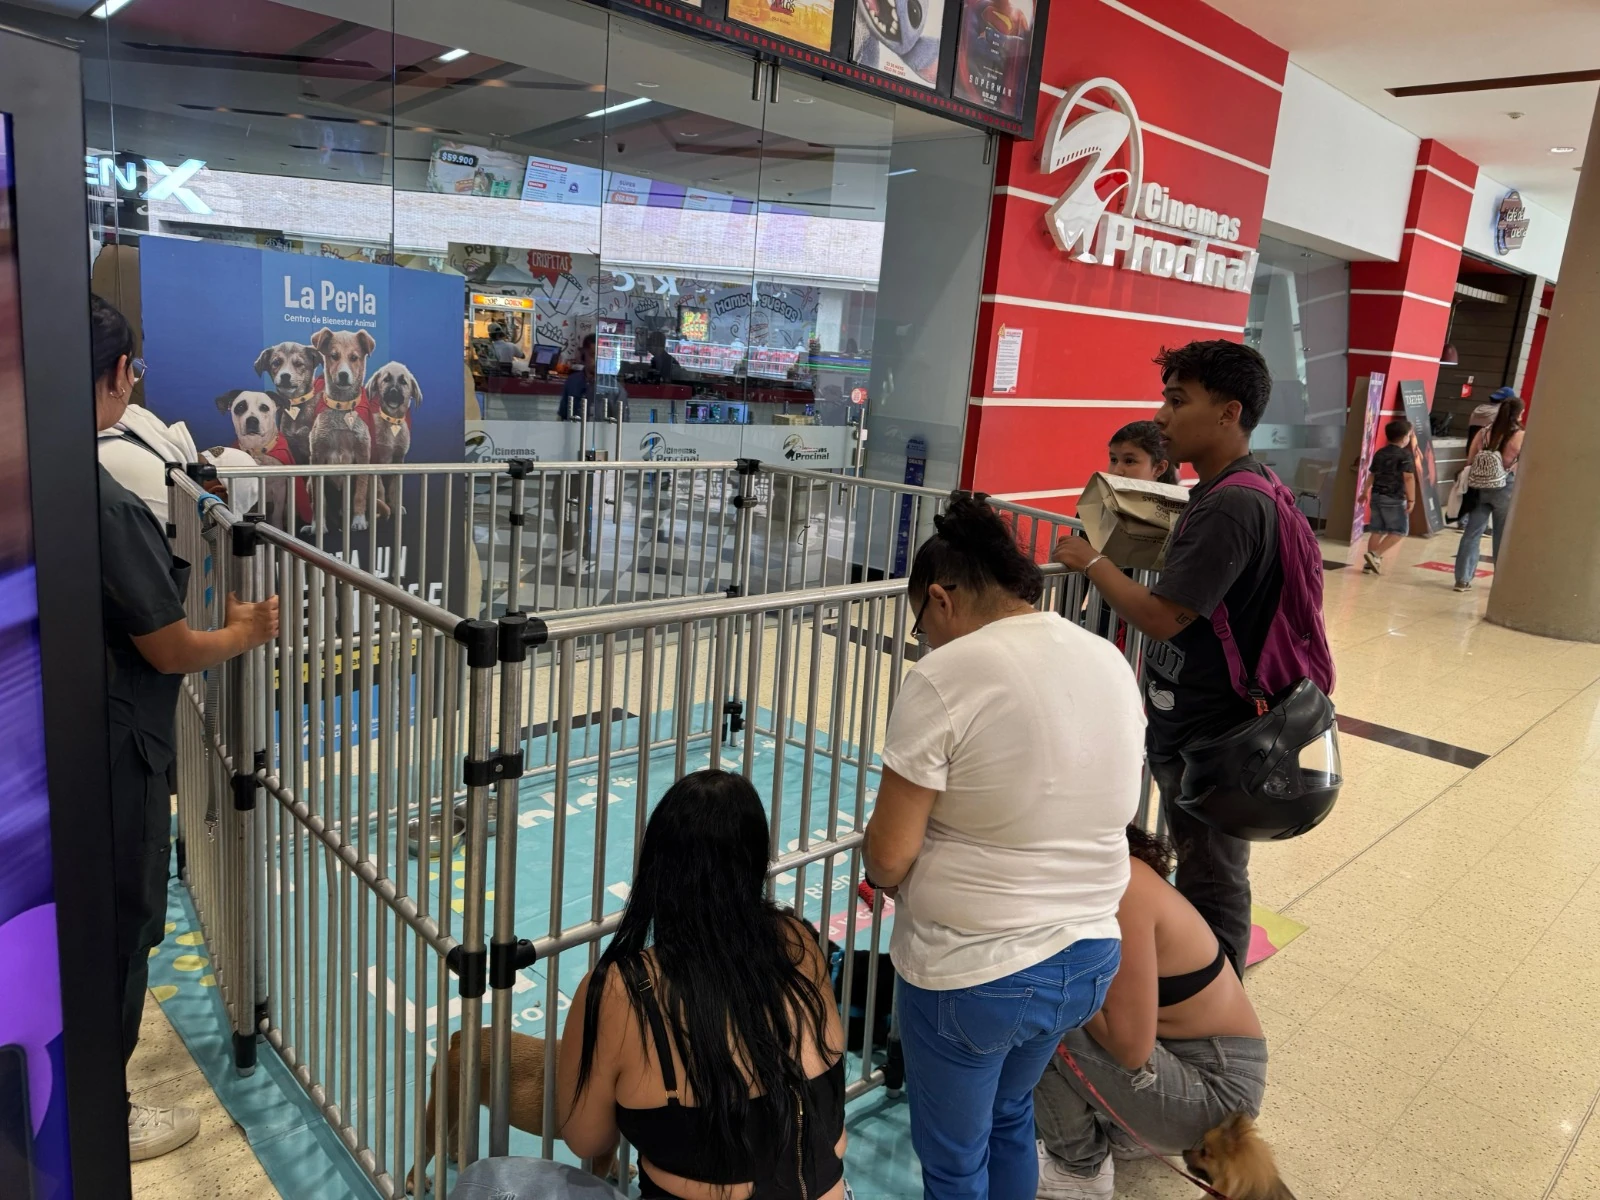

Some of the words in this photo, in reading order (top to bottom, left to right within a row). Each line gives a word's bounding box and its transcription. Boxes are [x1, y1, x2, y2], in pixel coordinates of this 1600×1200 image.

[969, 74, 1012, 97] SUPERMAN
[441, 151, 474, 166] $59.900
[1141, 182, 1241, 242] Cinemas
[532, 251, 568, 271] CRISPETAS
[1099, 214, 1259, 294] Procinal
[284, 275, 315, 310] La
[321, 280, 376, 315] Perla
[284, 313, 311, 323] Centro
[311, 315, 321, 324] de
[322, 316, 353, 326] Bienestar
[354, 319, 377, 328] Animal
[494, 447, 536, 456] Cinemas
[796, 452, 829, 461] Procinal
